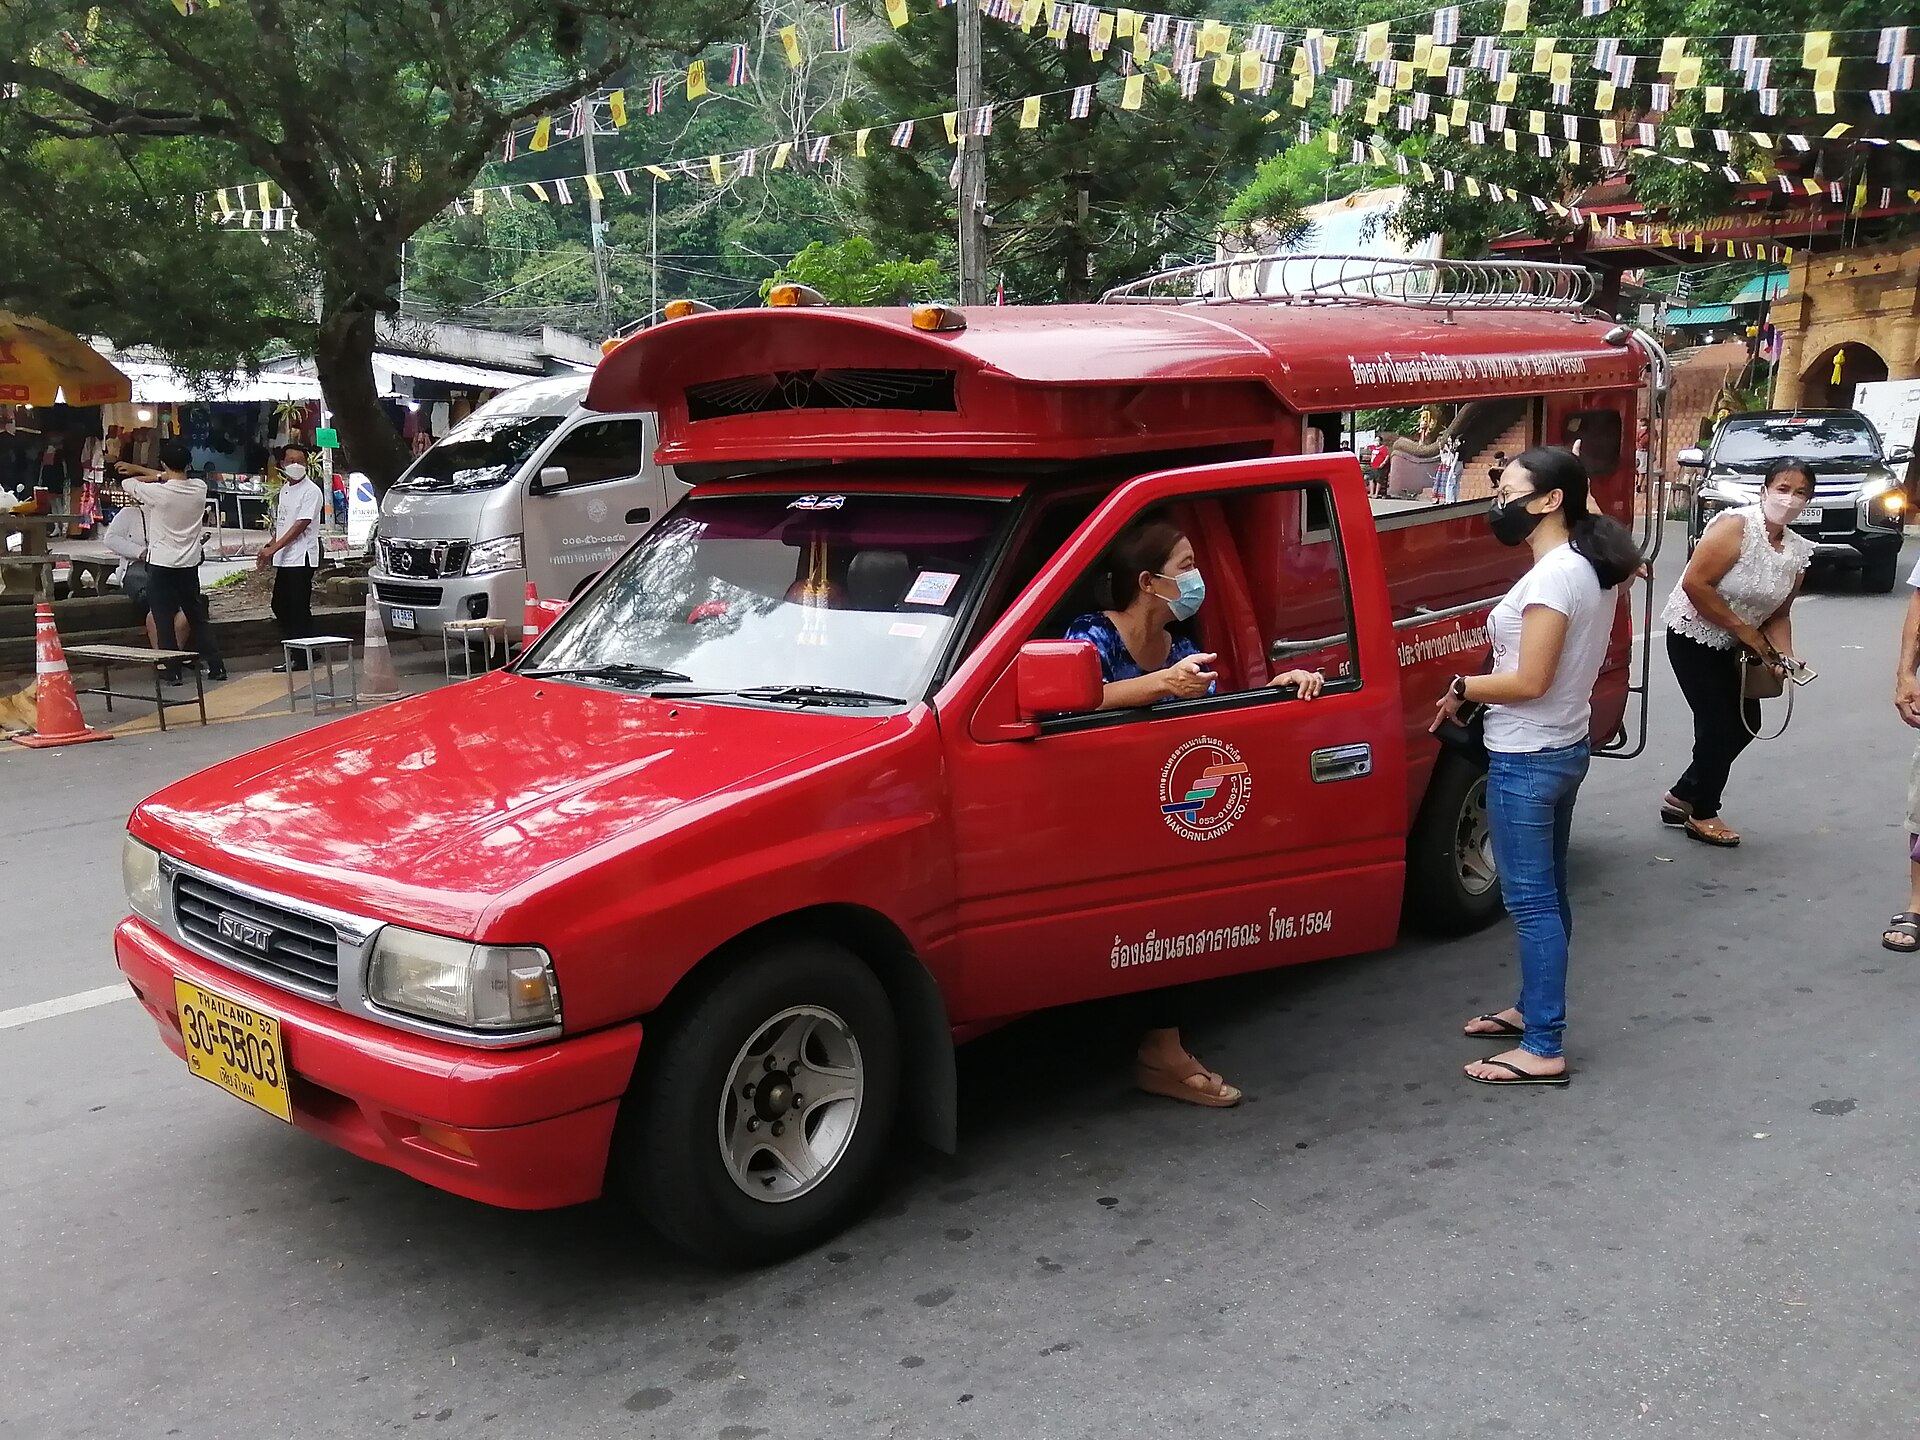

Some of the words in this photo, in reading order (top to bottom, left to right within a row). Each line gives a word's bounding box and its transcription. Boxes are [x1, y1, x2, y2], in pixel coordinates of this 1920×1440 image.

[1462, 360, 1477, 379] 30
[1518, 358, 1531, 377] 30
[1163, 814, 1235, 842] NAKORNLANNA
[217, 912, 273, 953] ISUZU
[1110, 928, 1262, 969] ร้องเรียนรถสาธารณะ
[197, 992, 253, 1027] THAILAND
[259, 1019, 271, 1036] 52
[183, 1004, 279, 1088] 30-5503
[219, 1067, 256, 1098] เชียงใหม่
